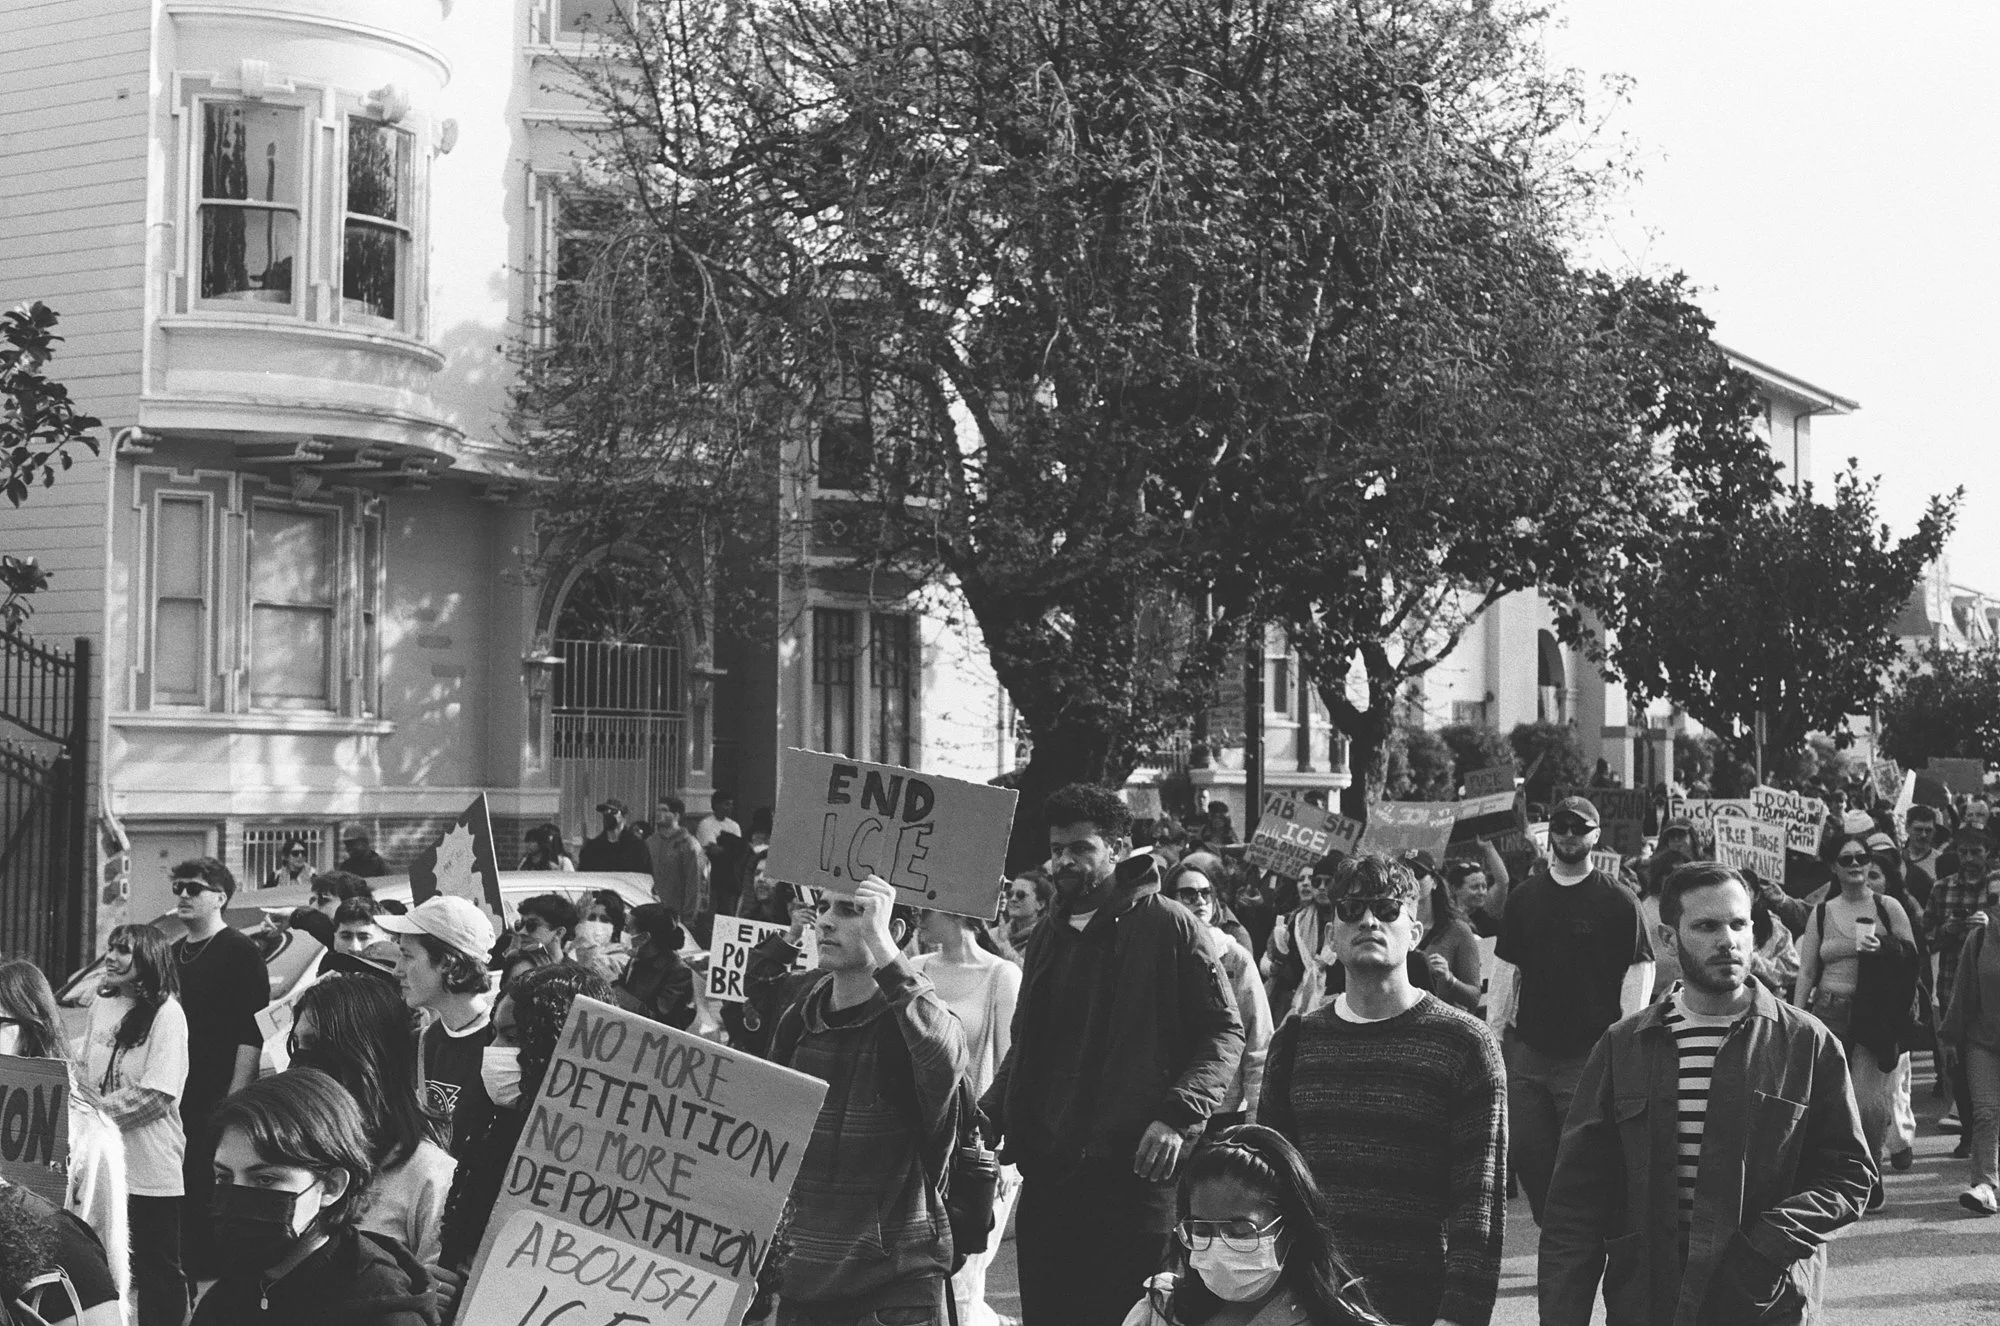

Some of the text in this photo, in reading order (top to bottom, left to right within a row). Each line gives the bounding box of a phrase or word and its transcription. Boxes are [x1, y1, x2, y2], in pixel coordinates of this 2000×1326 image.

[828, 764, 935, 822] END
[1777, 794, 1804, 811] CALL
[1255, 834, 1322, 864] COLONIZE
[1281, 822, 1328, 851] ICE
[1591, 853, 1617, 872] UT
[1717, 818, 1746, 844] FREE
[1750, 826, 1779, 853] THOSE
[568, 1010, 734, 1107] NO MORE
[546, 1058, 789, 1183] DETENTION
[525, 1105, 698, 1201] NO MORE
[507, 1155, 768, 1277] DEPORTATION
[506, 1221, 717, 1320] ABOLISH
